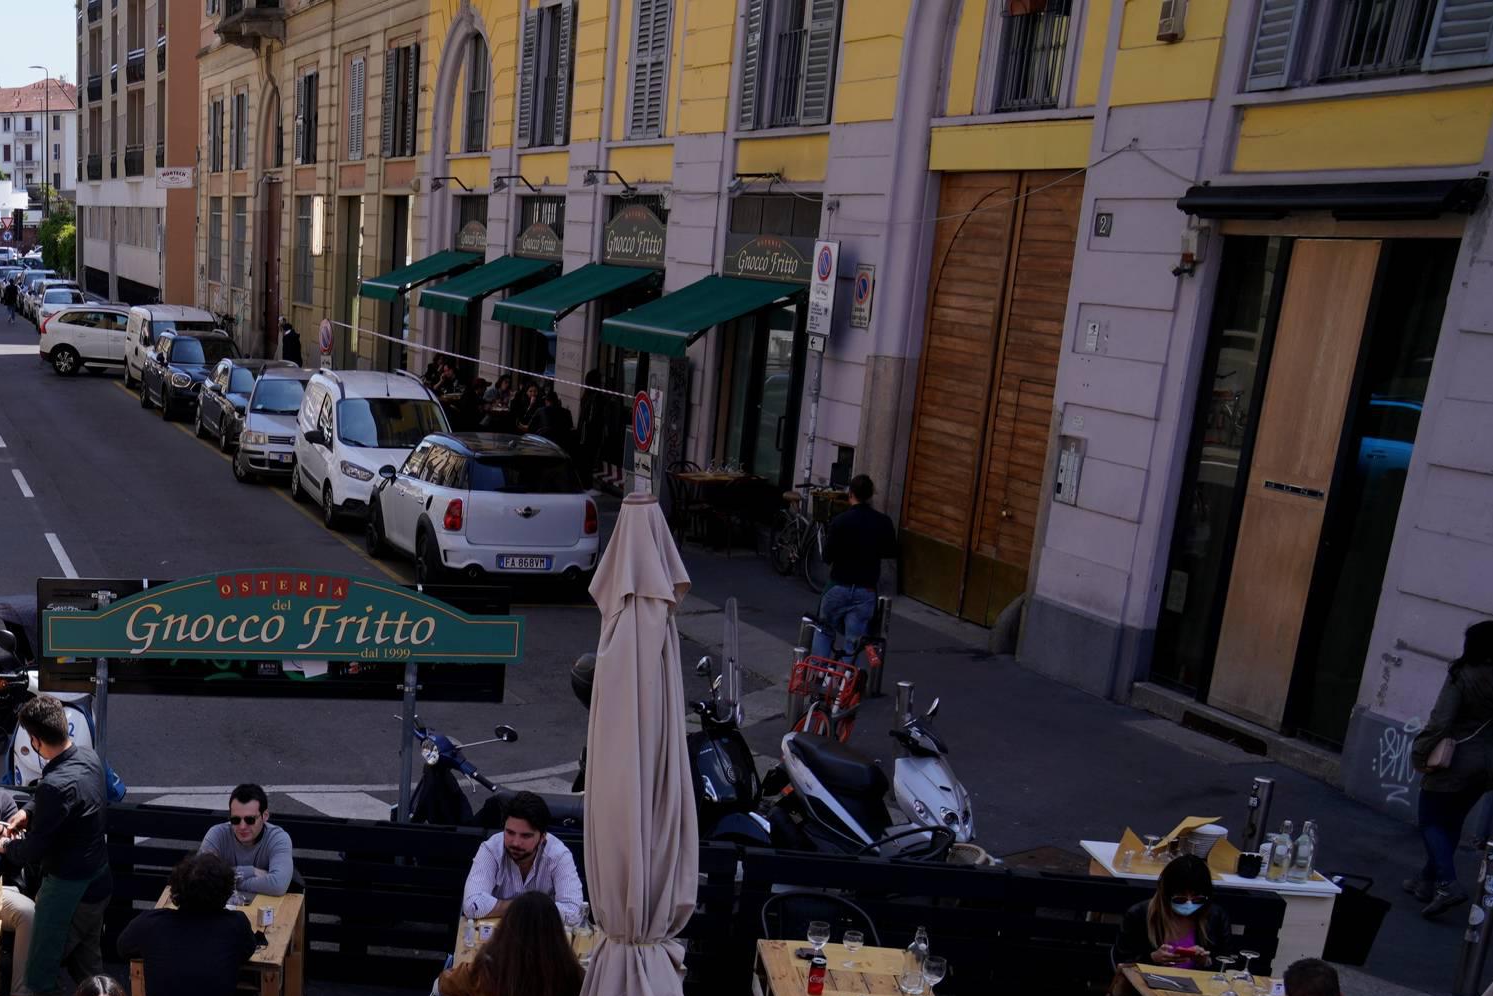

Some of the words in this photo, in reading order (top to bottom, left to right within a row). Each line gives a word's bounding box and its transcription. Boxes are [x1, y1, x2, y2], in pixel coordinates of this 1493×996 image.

[1099, 216, 1107, 234] 2
[607, 229, 636, 260] Gnocco
[635, 231, 663, 257] Fritto
[738, 249, 769, 276] Gnocco
[768, 251, 798, 275] Fritto
[505, 557, 516, 568] FA
[220, 580, 343, 597] OSTERIA
[272, 599, 292, 611] del
[125, 603, 285, 655] Gnocco
[297, 604, 436, 650] Fritto
[360, 648, 379, 659] dal
[382, 648, 411, 660] 1999
